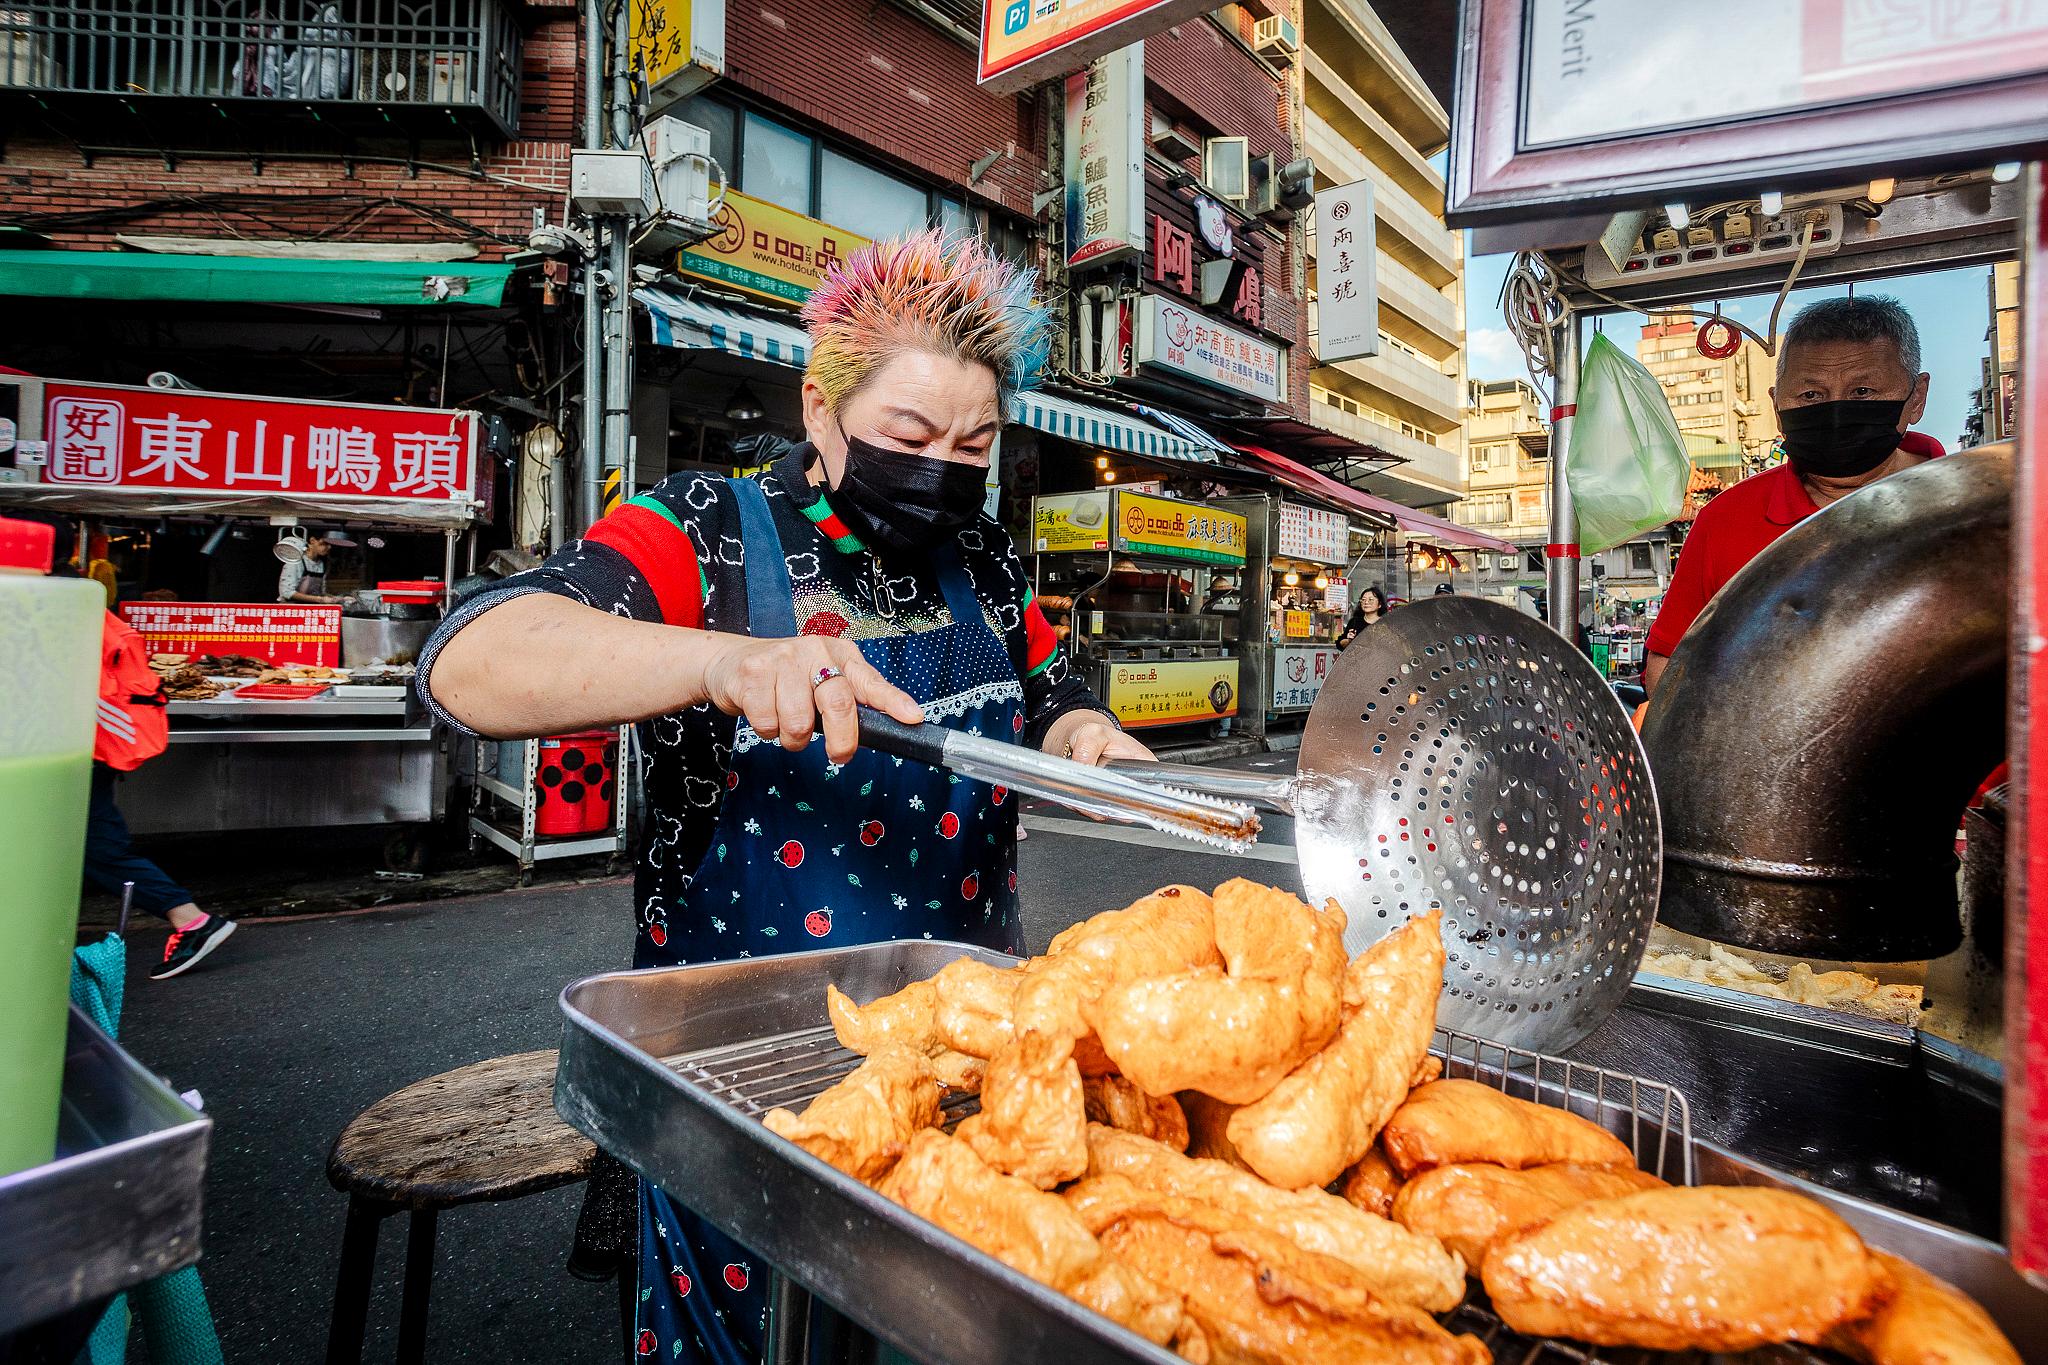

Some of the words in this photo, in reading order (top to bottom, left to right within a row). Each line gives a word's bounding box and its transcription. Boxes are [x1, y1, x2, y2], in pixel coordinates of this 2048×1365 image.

[1009, 6, 1025, 30] Pi
[1560, 0, 1595, 80] Merit
[1084, 157, 1108, 239] 鱸魚湯
[1080, 245, 1095, 256] FAST
[1095, 240, 1113, 251] FOOD
[1332, 227, 1357, 302] 兩喜號
[1194, 324, 1236, 358] 知高飯
[63, 404, 110, 477] 好記
[128, 412, 463, 494] 東山鴨頭
